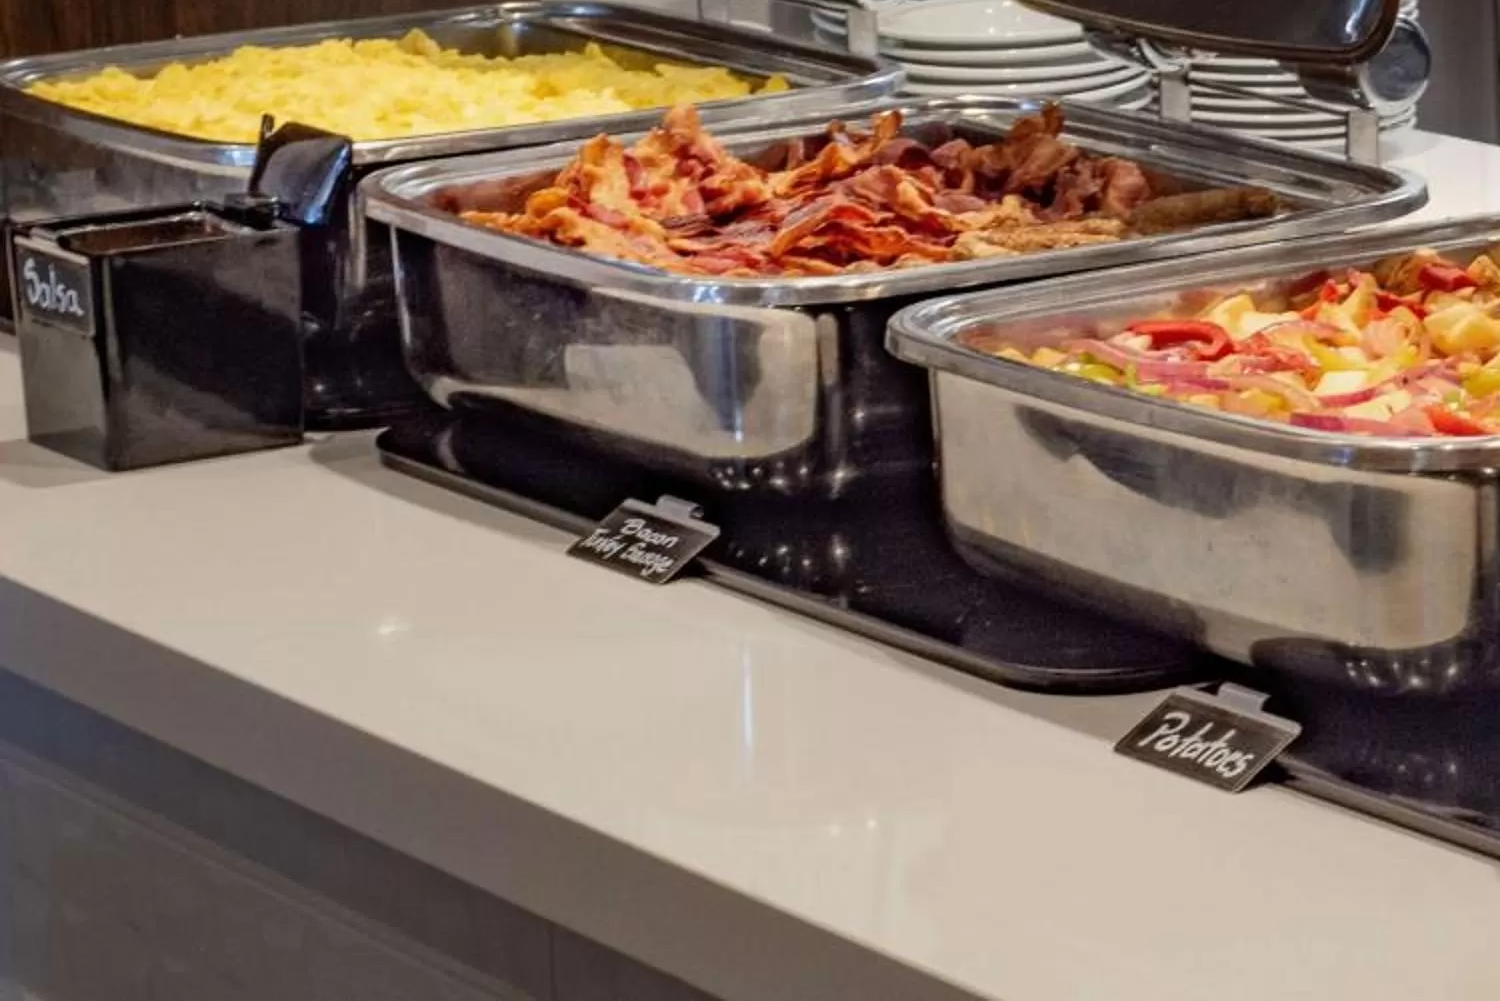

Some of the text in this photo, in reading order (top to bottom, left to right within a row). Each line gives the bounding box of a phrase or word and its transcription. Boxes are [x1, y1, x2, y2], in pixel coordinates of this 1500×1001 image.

[23, 258, 84, 317] Salsa
[620, 518, 679, 548] Bacon
[1137, 710, 1255, 778] Potatoes
